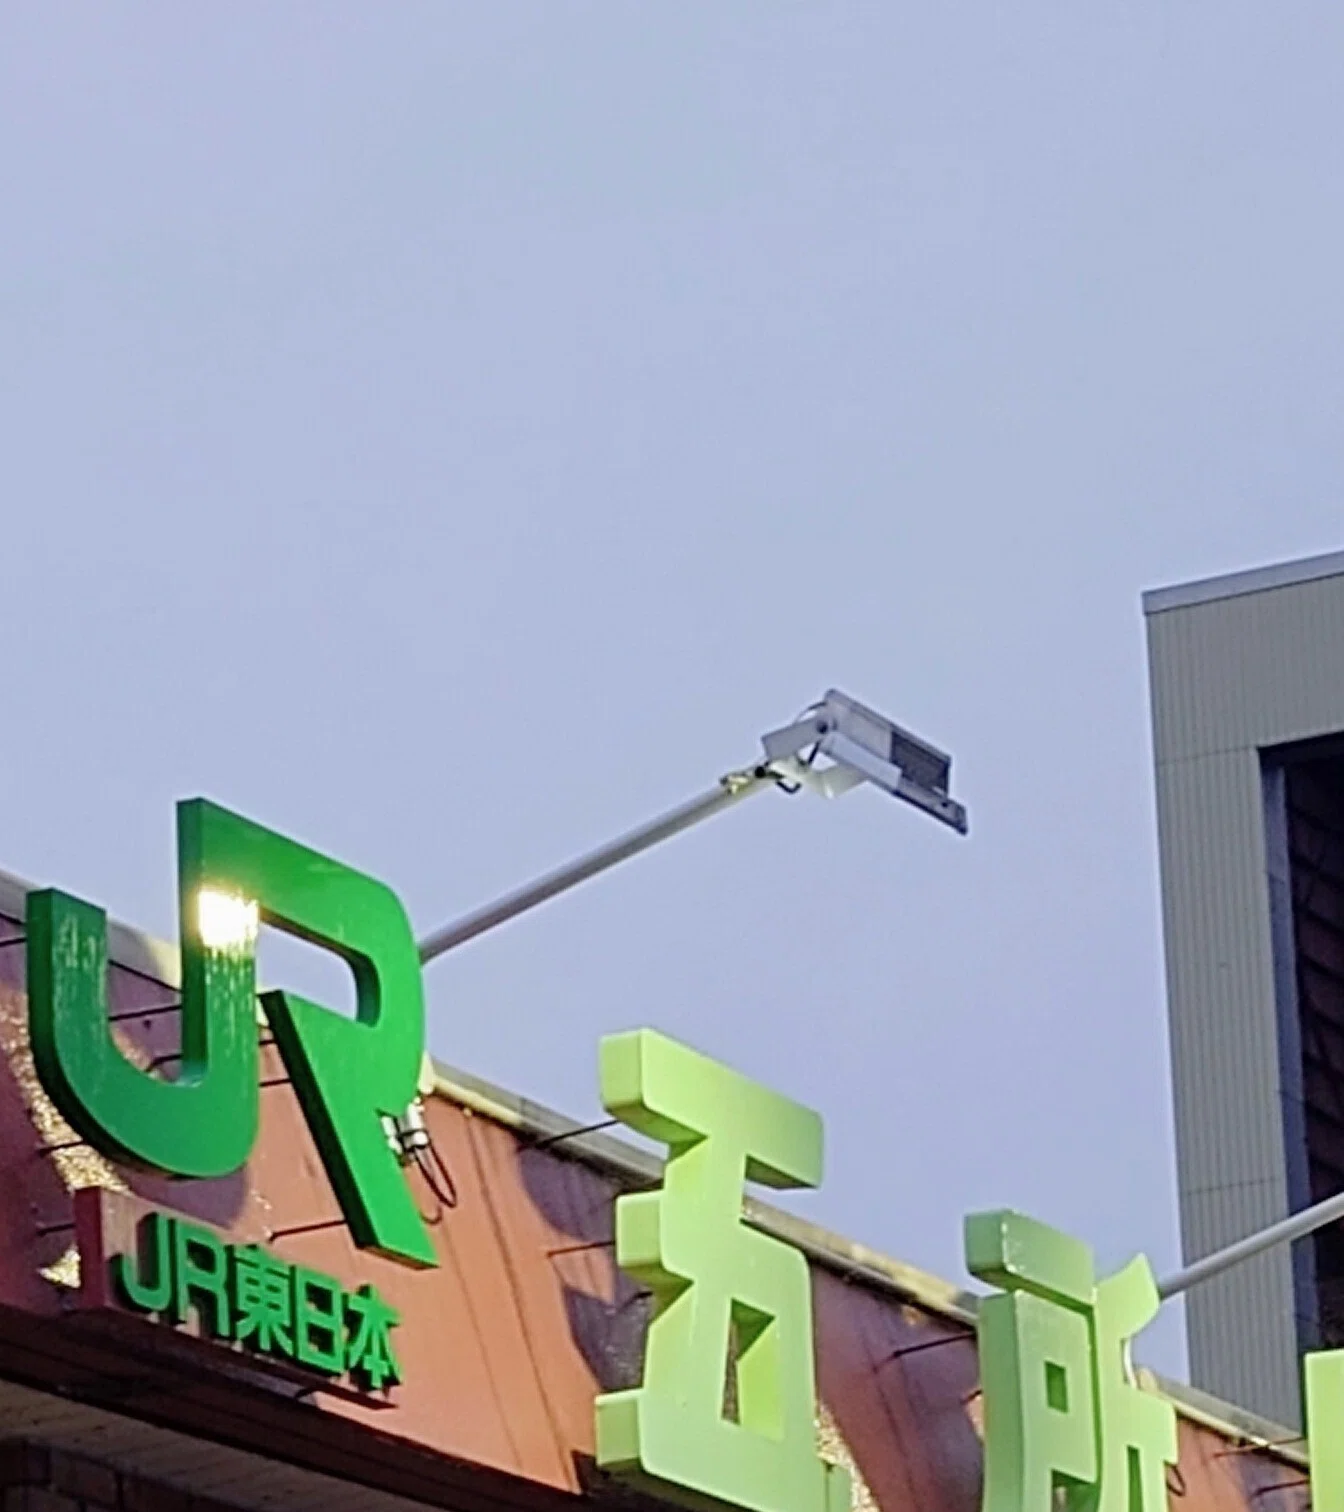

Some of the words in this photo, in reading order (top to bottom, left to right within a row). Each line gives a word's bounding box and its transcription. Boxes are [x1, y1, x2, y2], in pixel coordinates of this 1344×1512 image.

[26, 797, 439, 1268] JR
[110, 1211, 404, 1389] JR東日本
